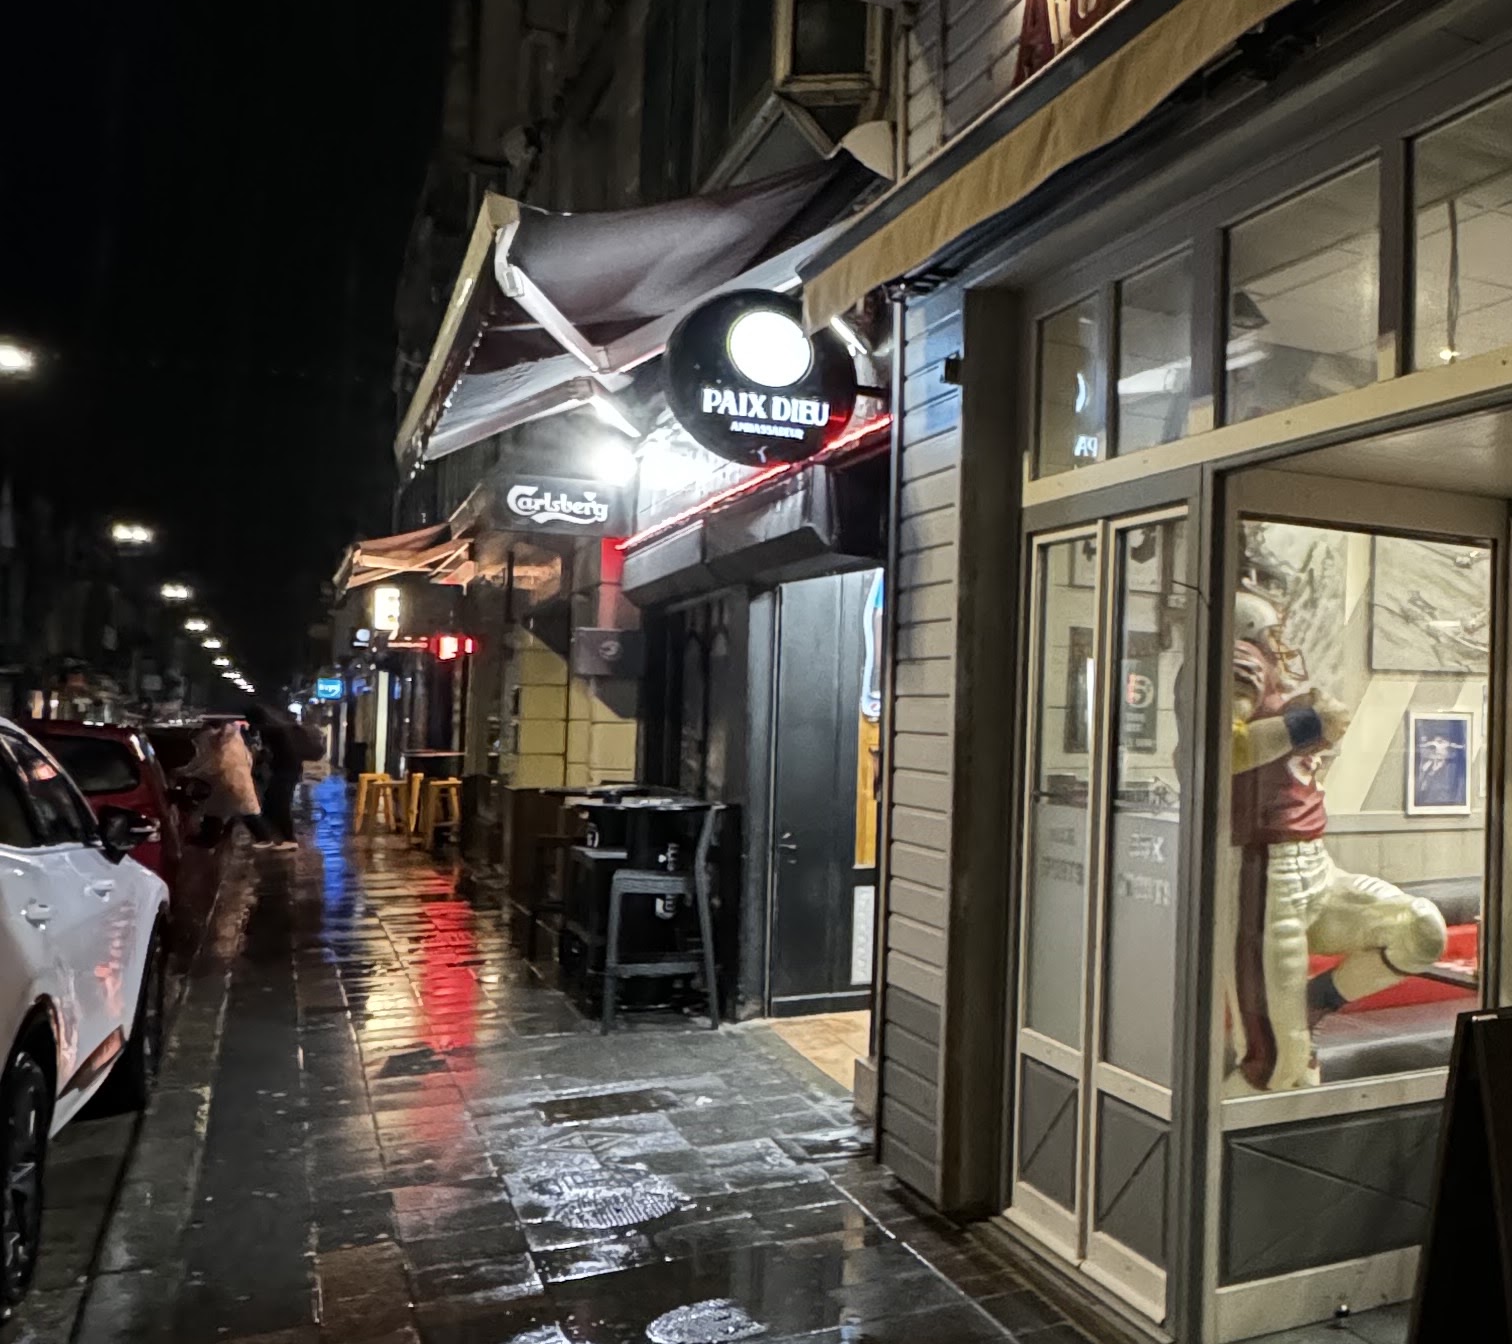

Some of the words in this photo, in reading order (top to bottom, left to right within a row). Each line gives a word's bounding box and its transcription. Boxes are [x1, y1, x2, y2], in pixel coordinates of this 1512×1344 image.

[702, 387, 768, 420] PAIX
[770, 396, 830, 428] DIEU
[507, 484, 609, 524] Carlsberg
